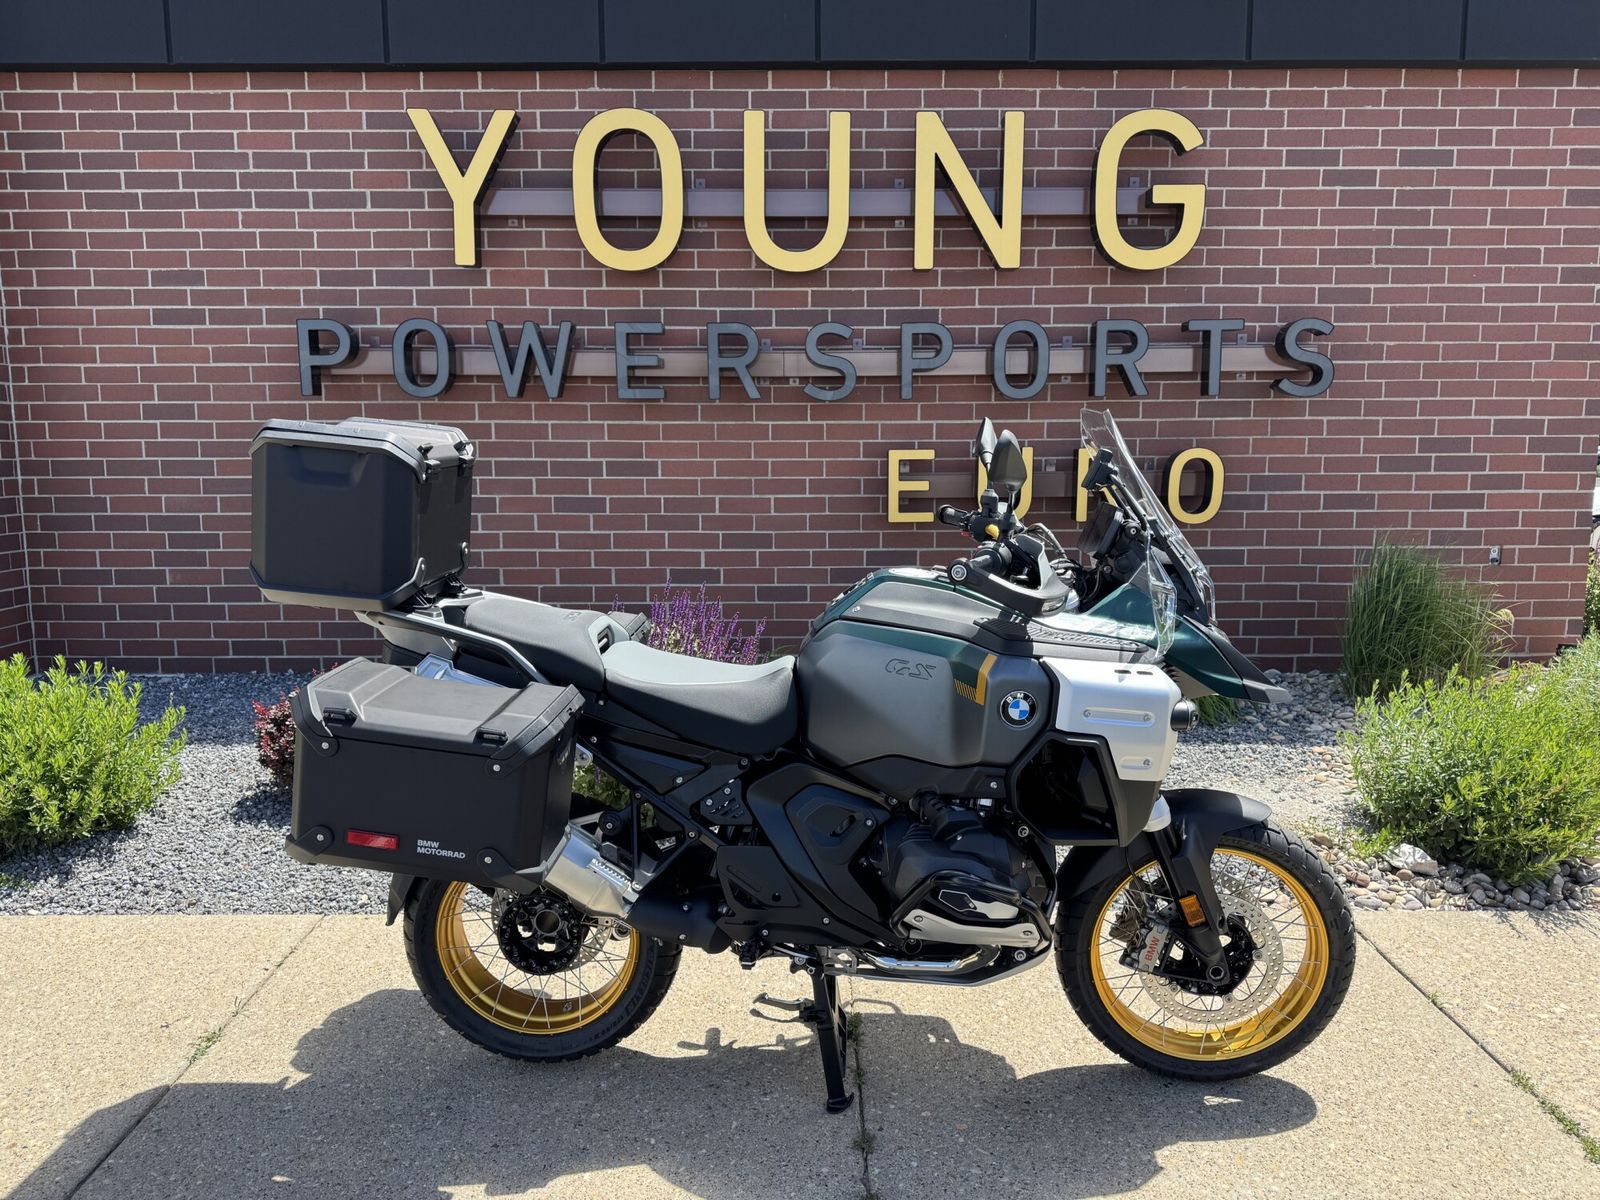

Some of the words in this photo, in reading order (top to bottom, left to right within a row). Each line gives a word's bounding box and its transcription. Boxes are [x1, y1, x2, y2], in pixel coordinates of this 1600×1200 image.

[406, 107, 1206, 272] YOUNG
[296, 318, 1336, 399] POWERSPORTS
[1005, 692, 1034, 705] BMW
[416, 846, 466, 859] MOTORRAD
[417, 839, 440, 848] BMW
[1144, 936, 1160, 961] BMW
